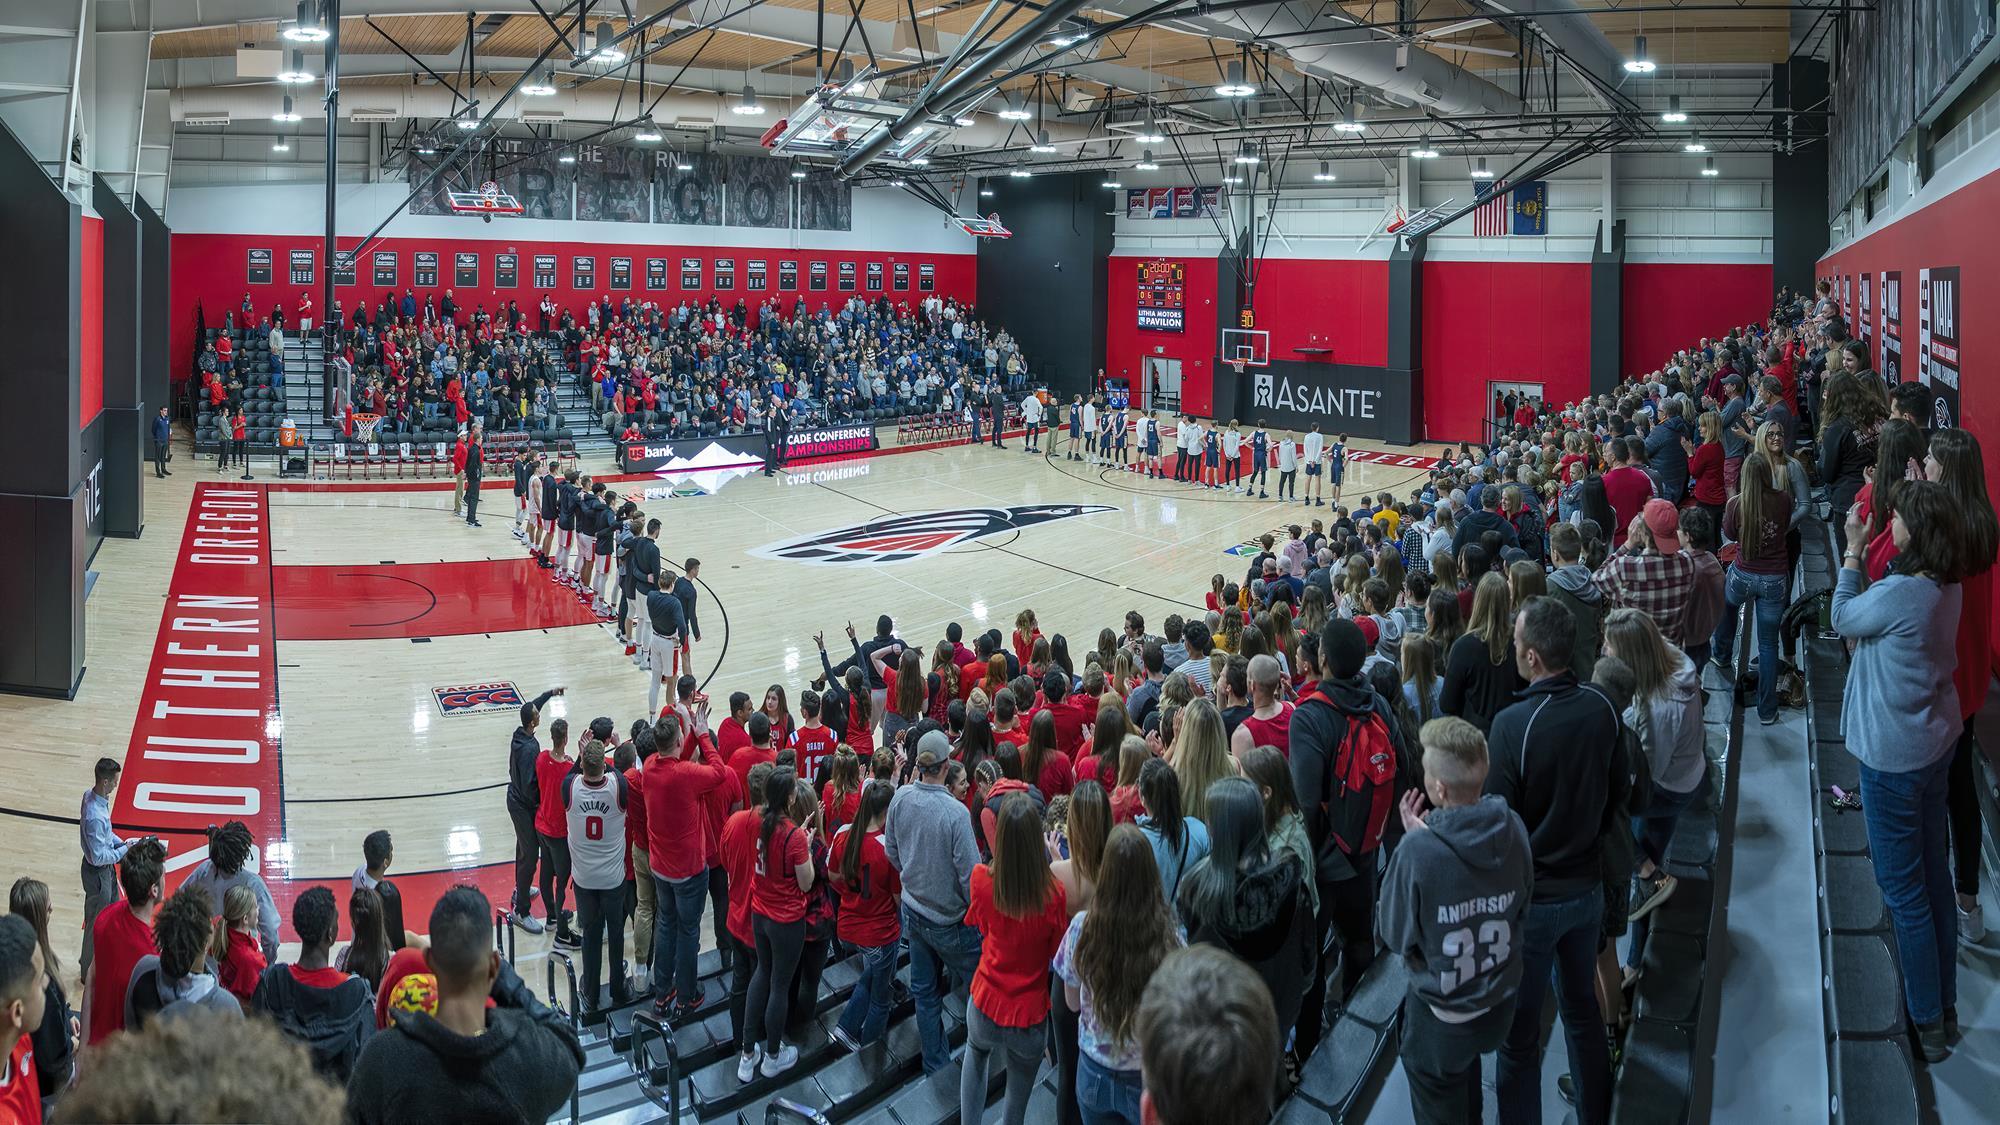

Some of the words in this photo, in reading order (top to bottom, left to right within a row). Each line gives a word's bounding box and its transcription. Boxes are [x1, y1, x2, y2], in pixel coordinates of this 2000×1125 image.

[1934, 280, 1954, 339] NAIA
[1146, 317, 1182, 327] PAVILION
[813, 427, 871, 443] CONFERENCE
[189, 489, 259, 565] OREGON
[434, 682, 512, 694] CASCADE
[483, 705, 522, 713] CONFERENC
[806, 742, 825, 752] BRADY
[579, 800, 610, 815] LILLARD
[585, 815, 604, 841] 0
[1437, 890, 1516, 924] ANDERSON
[1440, 919, 1512, 996] 33
